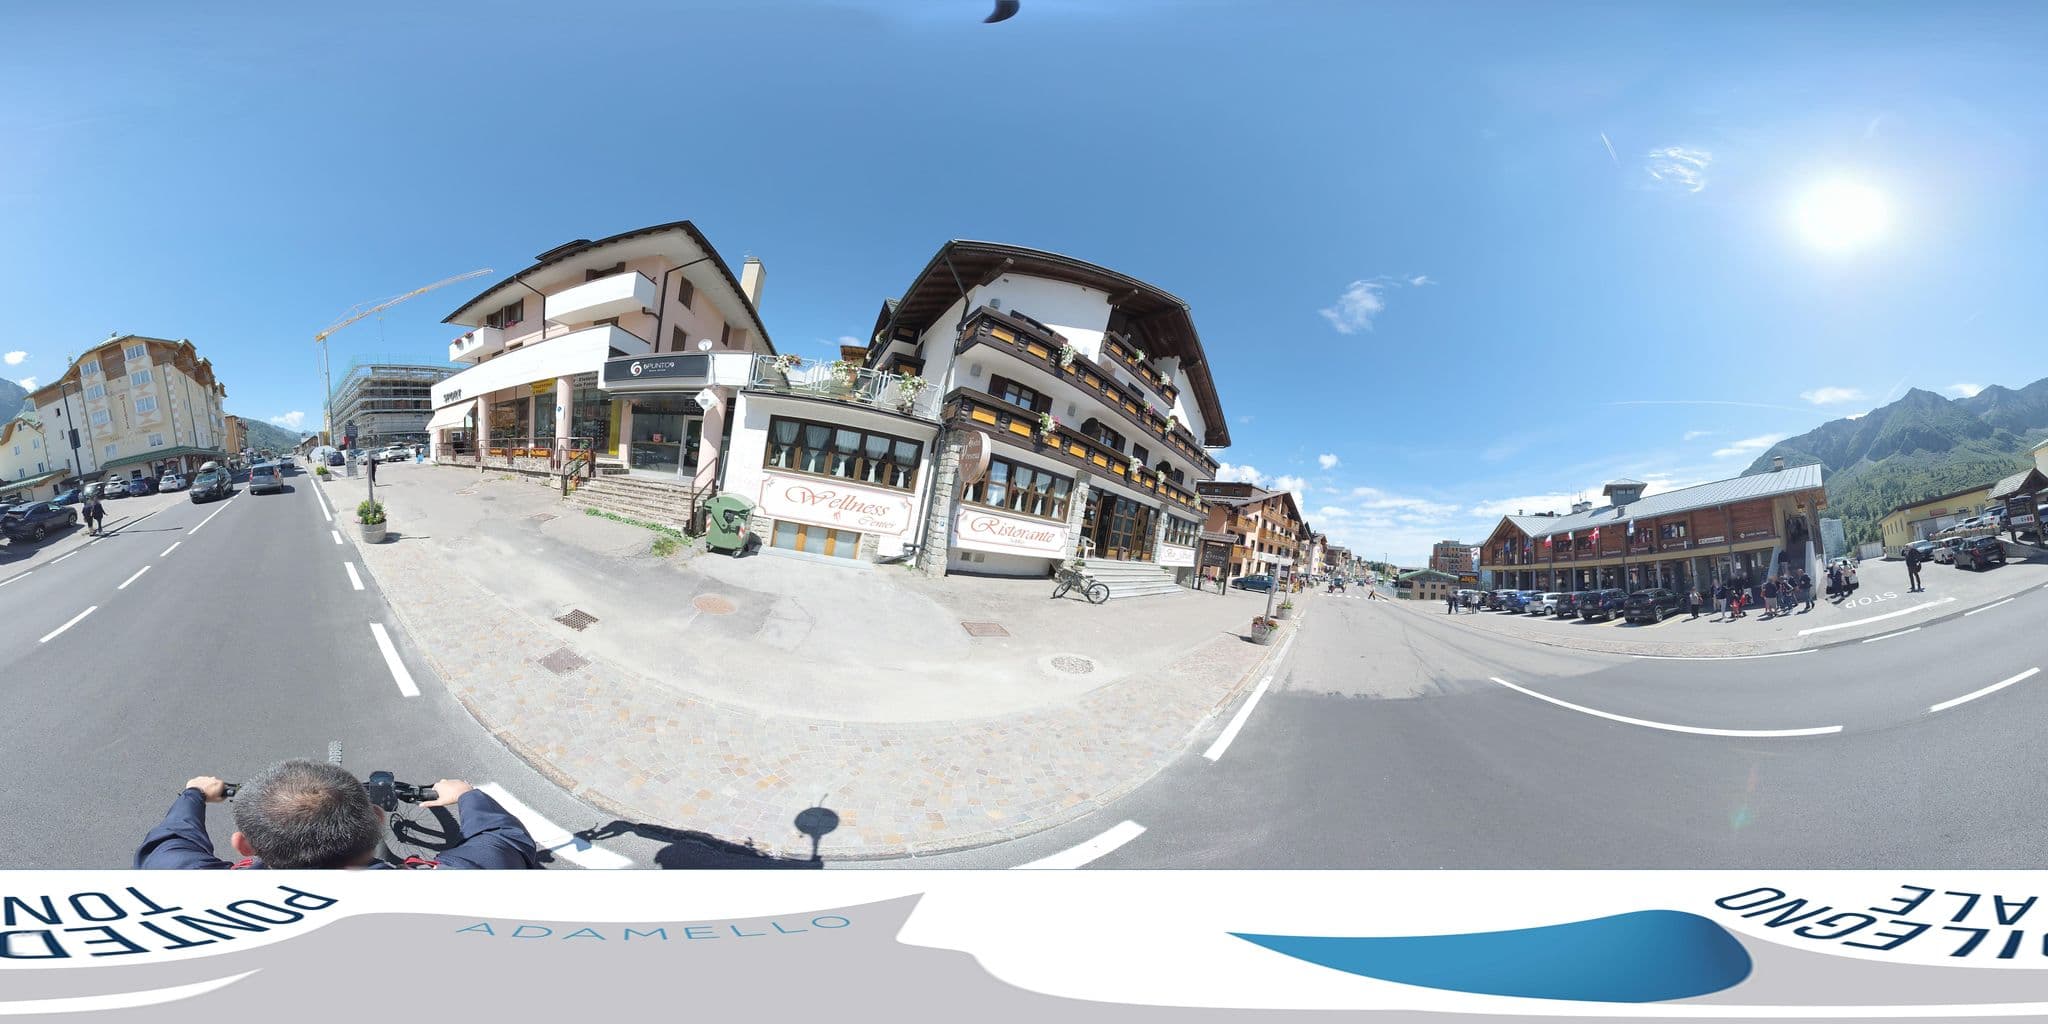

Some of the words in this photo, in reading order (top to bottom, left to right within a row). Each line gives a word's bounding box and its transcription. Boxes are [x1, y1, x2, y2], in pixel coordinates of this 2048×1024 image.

[785, 486, 891, 516] Wellness
[858, 516, 896, 529] Center
[971, 516, 1056, 543] Ristorante
[1845, 592, 1898, 609] STOP
